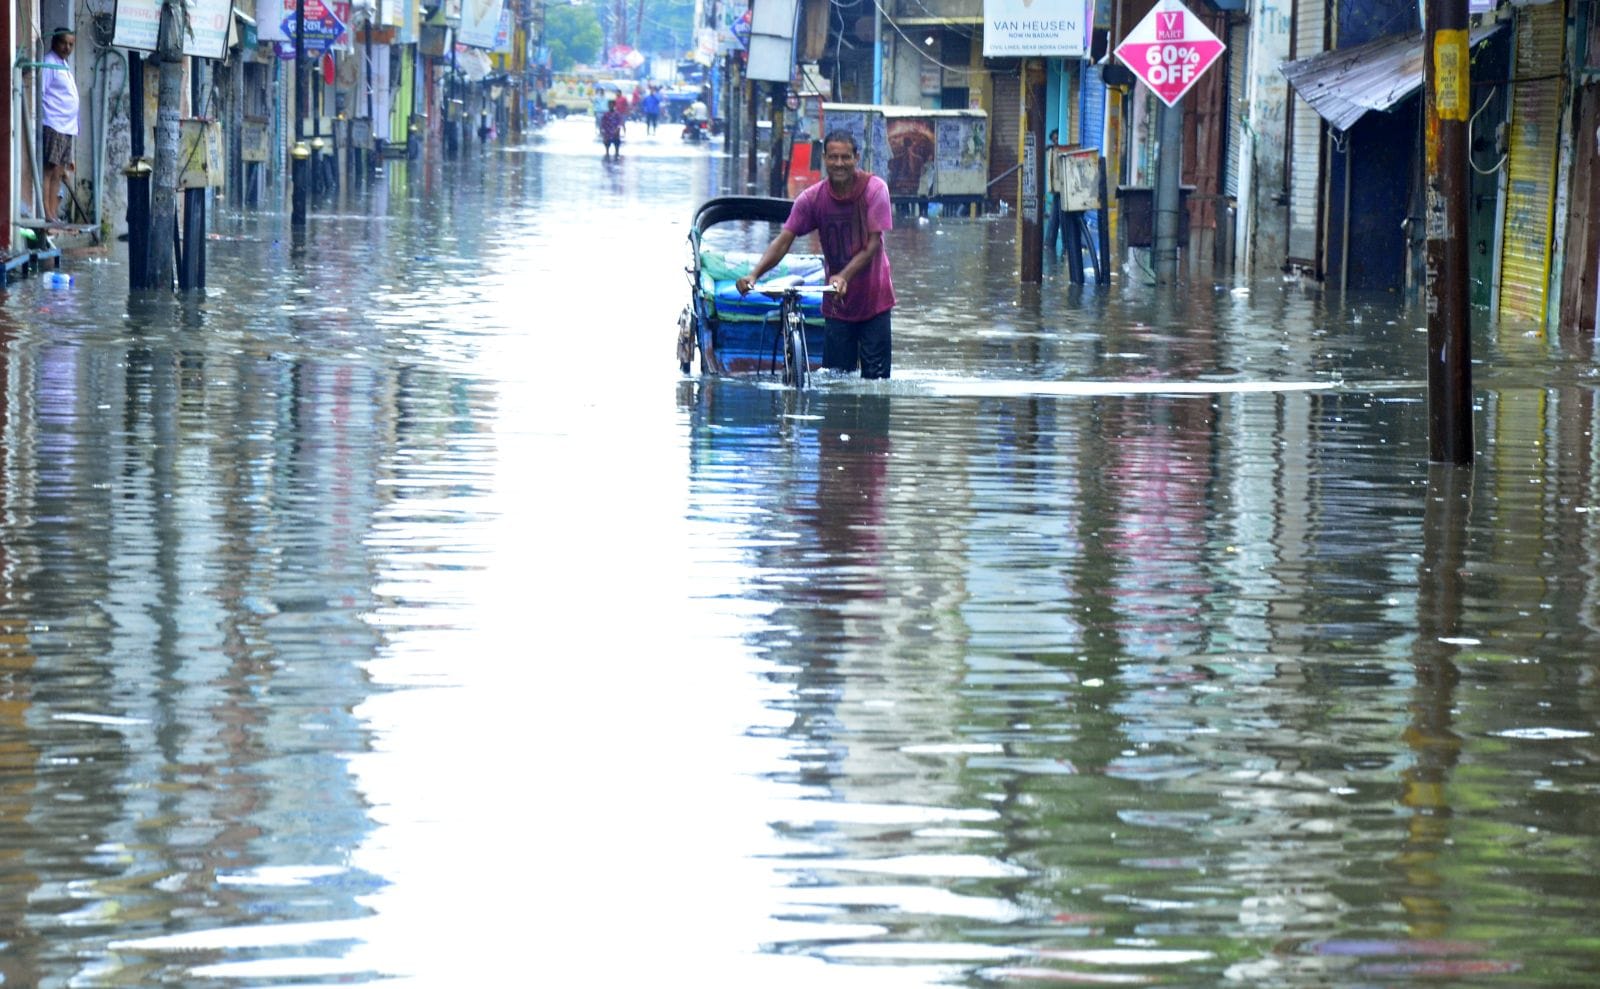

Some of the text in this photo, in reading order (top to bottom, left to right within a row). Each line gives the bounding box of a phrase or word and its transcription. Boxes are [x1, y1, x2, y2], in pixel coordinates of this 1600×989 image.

[993, 20, 1076, 31] VAN HEUSEN
[1162, 13, 1178, 30] V
[1158, 30, 1182, 39] MART
[1146, 45, 1200, 65] 60%
[1147, 64, 1195, 85] OFF
